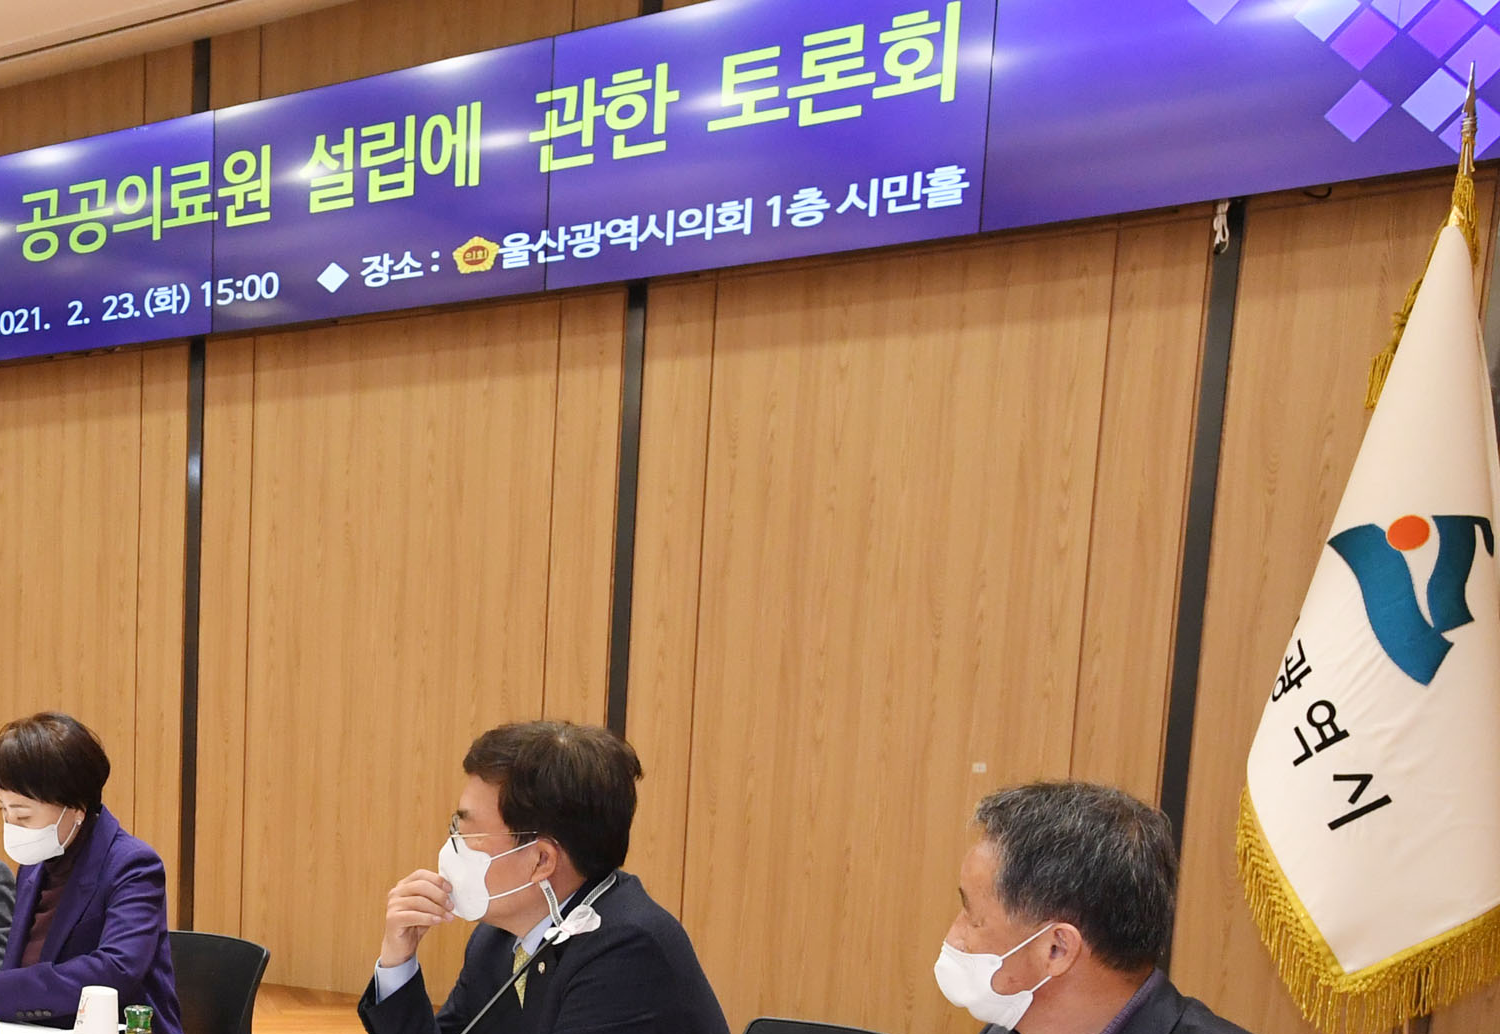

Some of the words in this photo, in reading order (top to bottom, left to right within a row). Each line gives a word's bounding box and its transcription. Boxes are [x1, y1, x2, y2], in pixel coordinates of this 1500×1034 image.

[15, 143, 274, 263] 공공의료원
[297, 101, 482, 214] 설립에
[529, 62, 680, 174] 관한
[706, 0, 962, 132] 토론회
[497, 197, 754, 269] 울산광역시의회
[765, 188, 828, 229] 1층
[836, 164, 971, 217] 시민홀
[199, 271, 280, 308] 15:00
